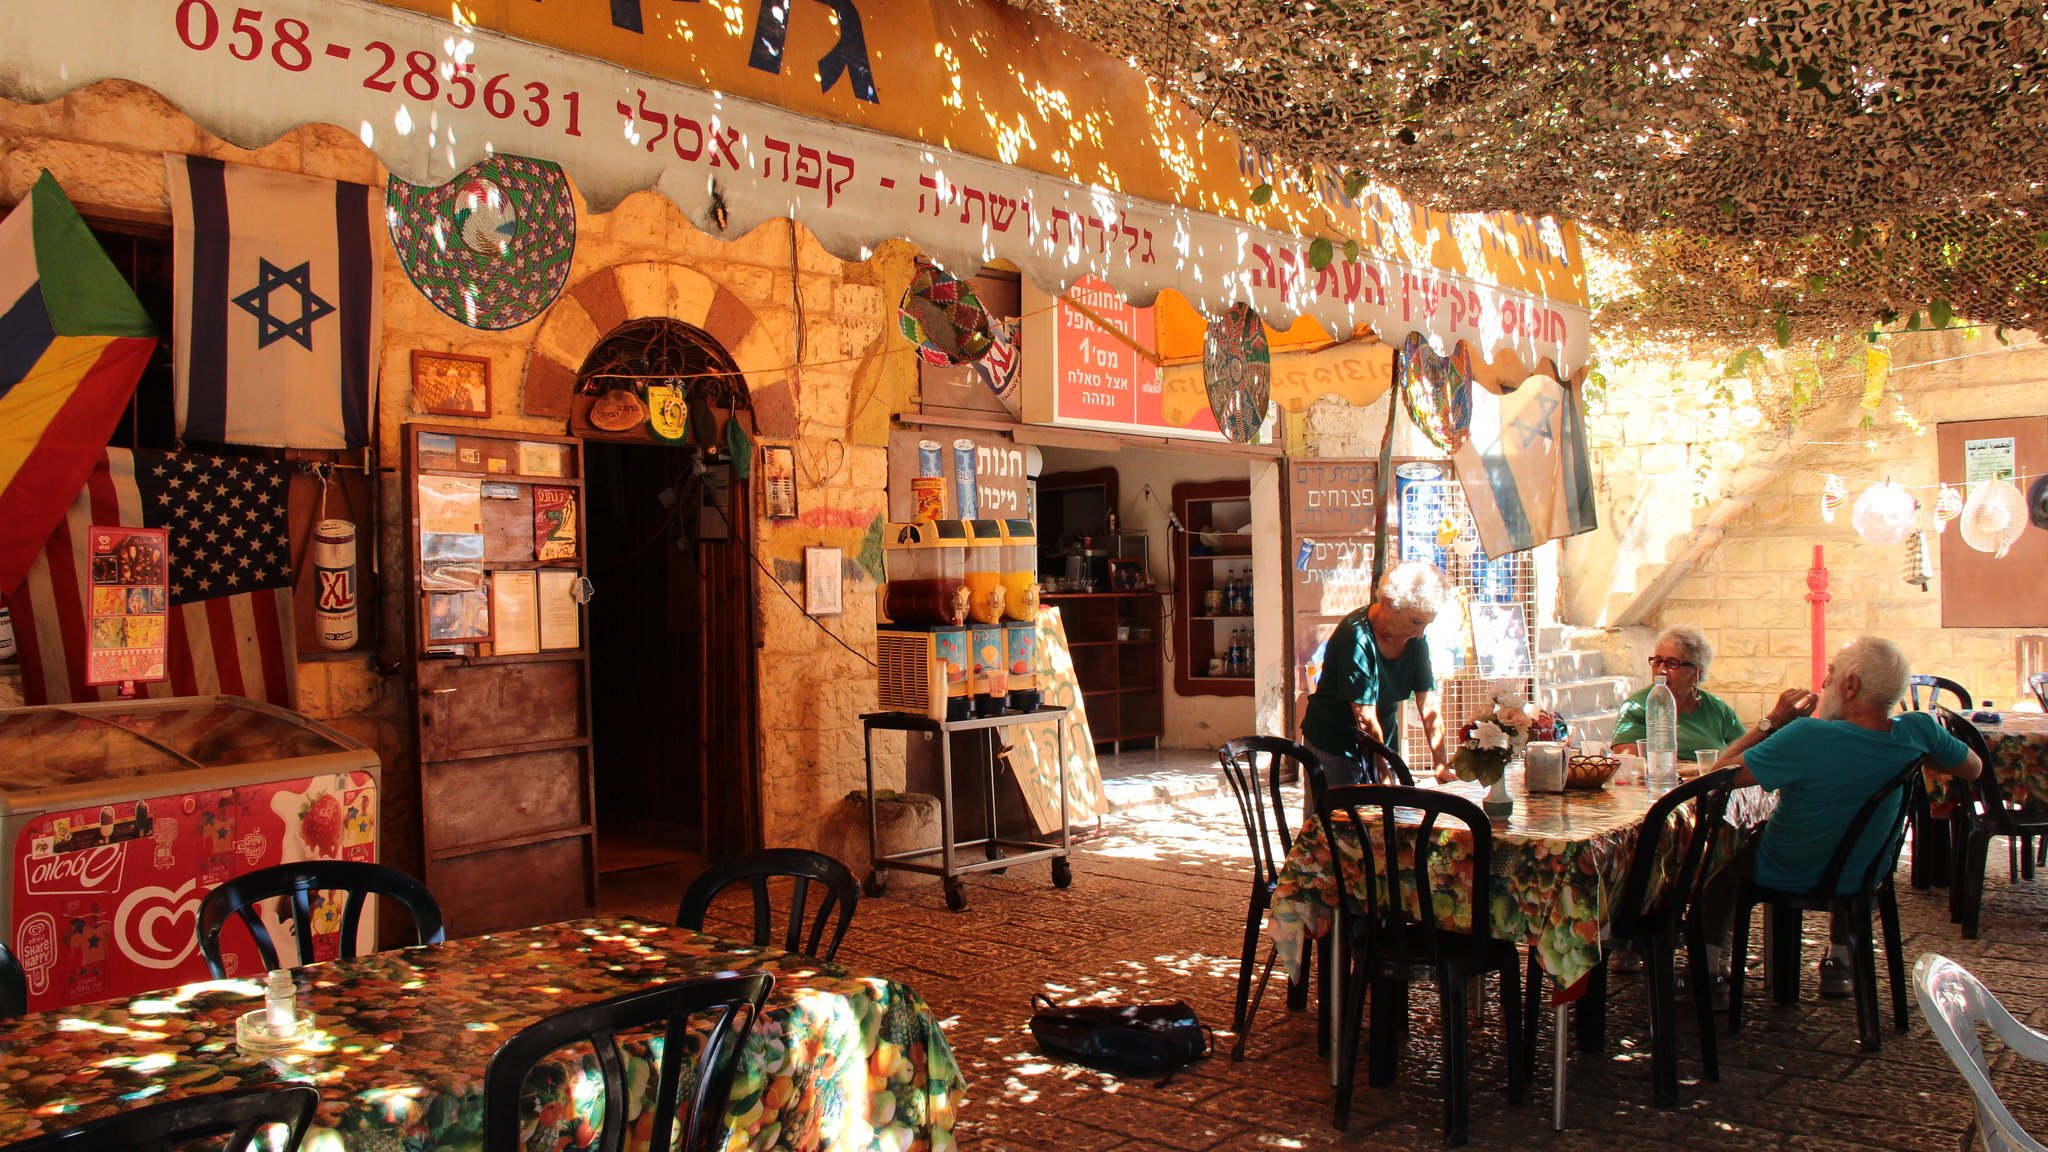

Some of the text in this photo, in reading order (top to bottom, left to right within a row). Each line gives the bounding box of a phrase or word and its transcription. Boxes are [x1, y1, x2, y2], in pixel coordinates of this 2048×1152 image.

[175, 0, 582, 137] 058-285631
[617, 89, 739, 171] אסלי
[764, 135, 854, 208] קפה
[919, 173, 1032, 238] ושתיה
[1050, 206, 1156, 265] גלידות
[1068, 369, 1101, 386] סאלח
[1106, 373, 1128, 390] אצל
[977, 445, 1022, 478] חנות
[1308, 489, 1374, 507] פצוחים
[1316, 537, 1375, 560] פילמים
[321, 570, 355, 608] XL
